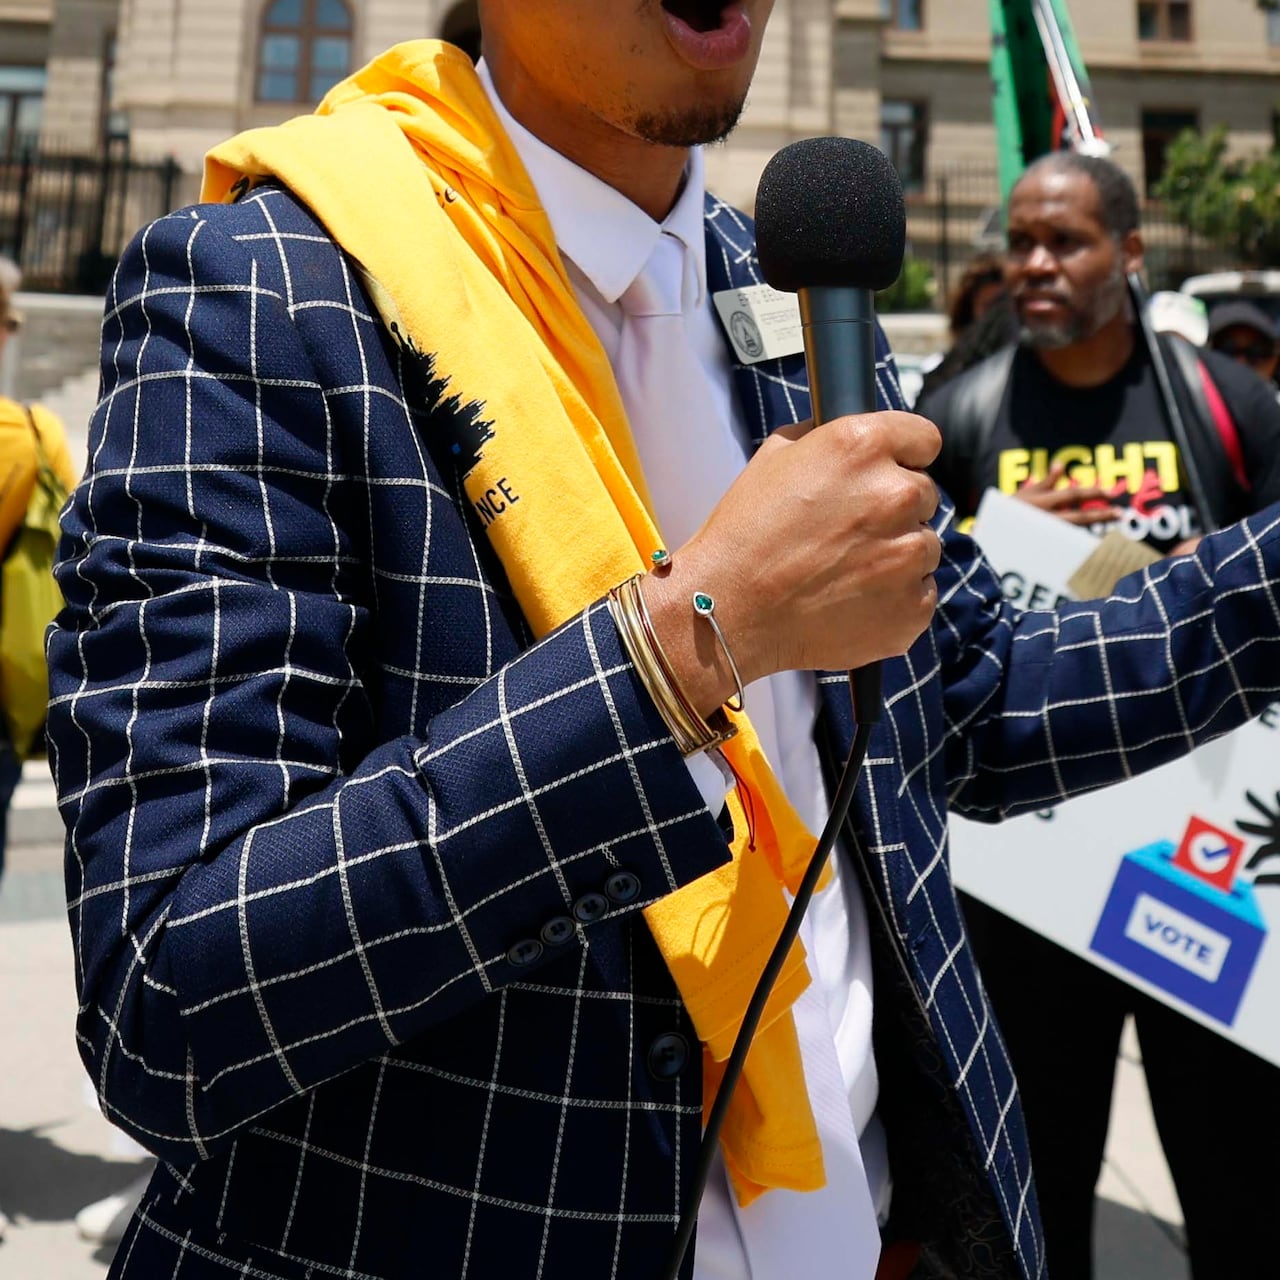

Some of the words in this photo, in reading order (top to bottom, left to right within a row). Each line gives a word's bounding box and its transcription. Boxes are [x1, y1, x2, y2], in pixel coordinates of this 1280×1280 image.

[997, 440, 1180, 496] FIGHT
[475, 477, 520, 528] NCE
[1144, 913, 1215, 965] VOTE
